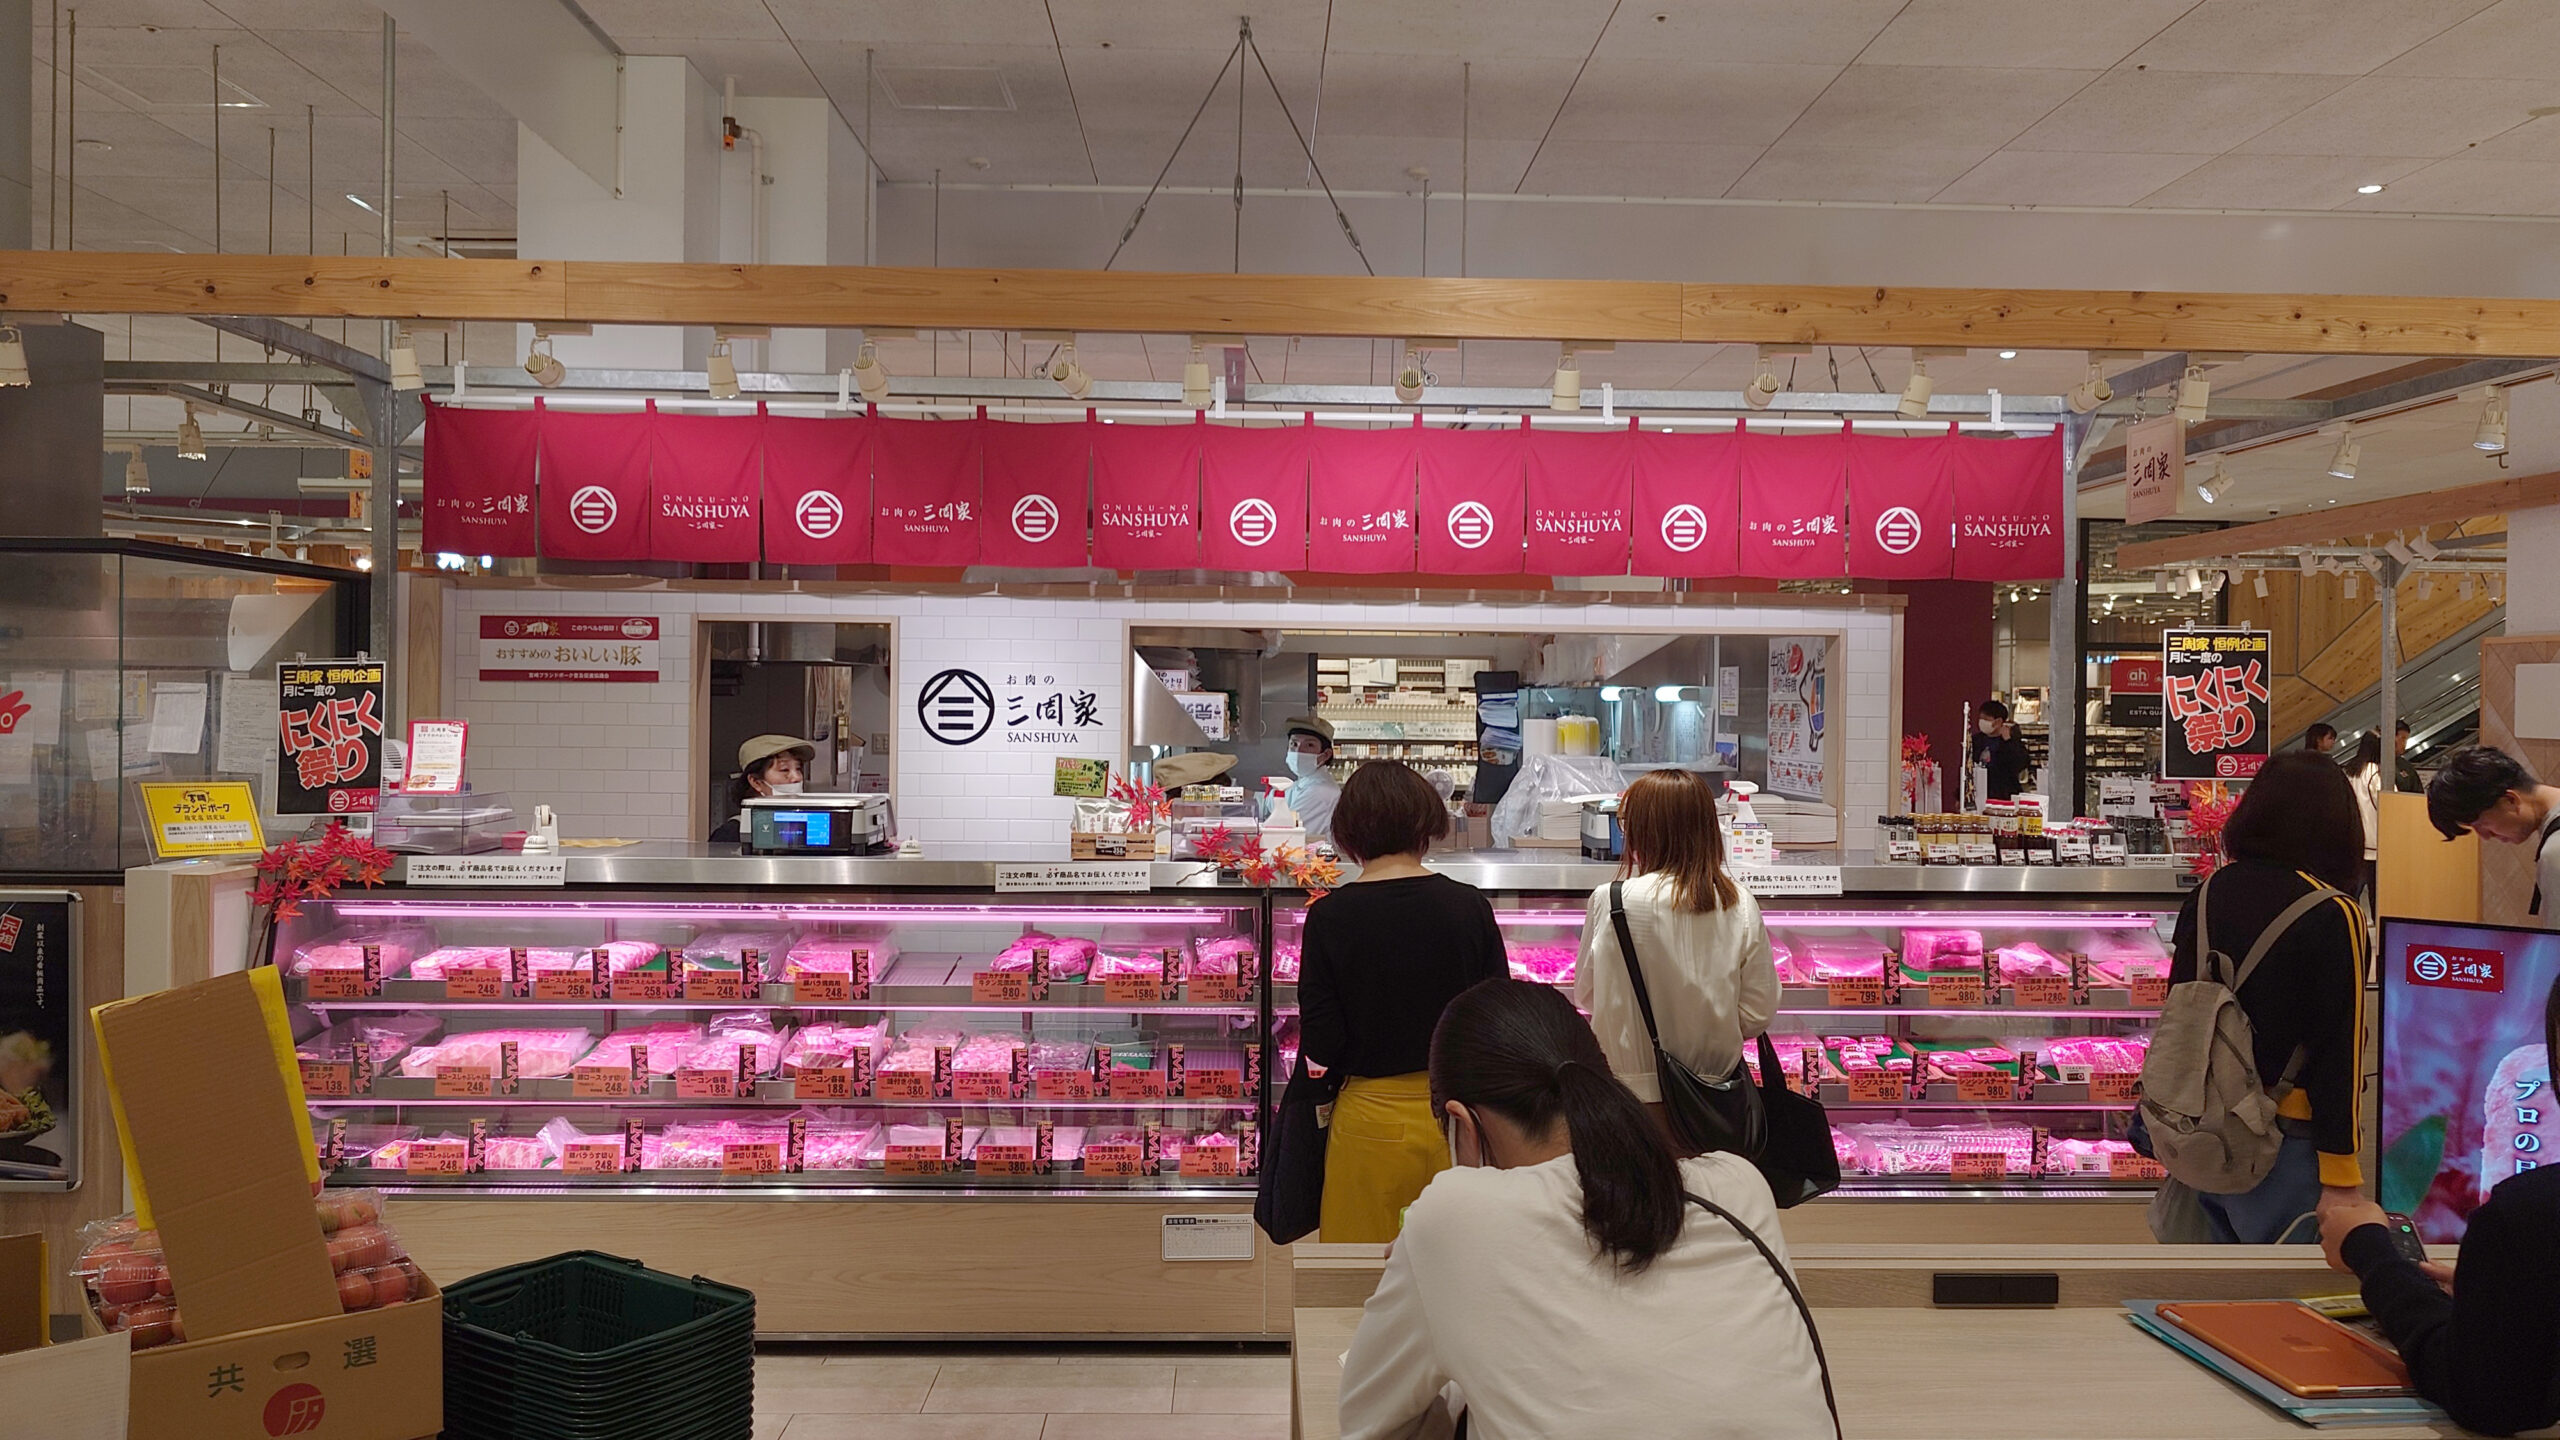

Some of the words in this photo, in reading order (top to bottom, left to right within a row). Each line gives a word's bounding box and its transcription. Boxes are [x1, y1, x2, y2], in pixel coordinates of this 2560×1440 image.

[663, 495, 750, 503] ONIKU-NO
[662, 503, 751, 518] SANSHUYA
[1102, 503, 1189, 511] ONIKU-NO
[1102, 512, 1190, 527] SANSHUYA
[1536, 509, 1622, 518] ONIKU-NO
[1964, 514, 2050, 522] ONIKU-NO
[461, 516, 508, 525] SANSHUYA
[1535, 518, 1623, 533] SANSHUYA
[904, 524, 950, 533] SANSHUYA
[1964, 522, 2052, 537] SANSHUYA
[1342, 534, 1387, 543] SANSHUYA
[1772, 538, 1816, 547] SANSHUYA
[2169, 638, 2210, 651] 三周家
[2213, 637, 2267, 652] 恒例企画
[2169, 652, 2223, 664] 月に一度の
[283, 670, 323, 685] 三周家
[327, 668, 382, 684] 恒例企画
[1006, 674, 1055, 686] お肉の
[283, 685, 336, 697] 月に一度の
[2166, 659, 2269, 721] にくにく
[280, 690, 383, 756] にくにく
[2183, 704, 2256, 754] 祭り
[1006, 732, 1078, 743] SANSHUYA
[296, 738, 369, 790] 祭り
[2451, 976, 2483, 985] SANSHUYA
[208, 1363, 245, 1398] 共
[343, 1336, 377, 1369] 選
